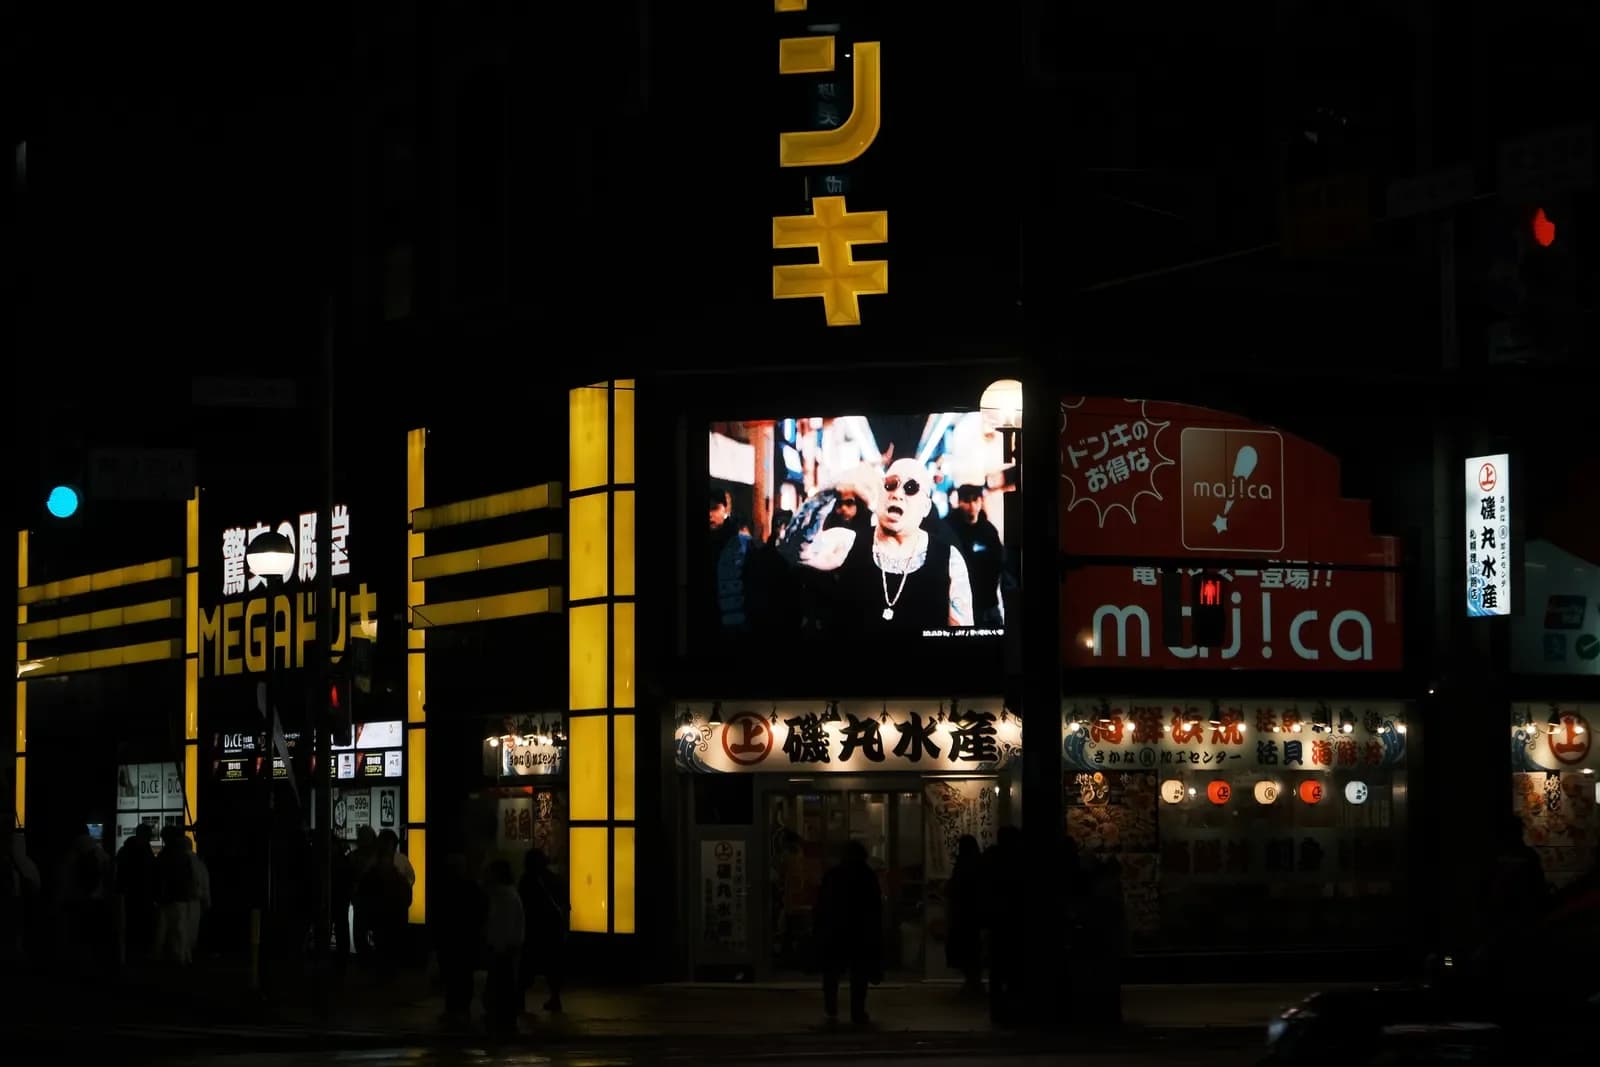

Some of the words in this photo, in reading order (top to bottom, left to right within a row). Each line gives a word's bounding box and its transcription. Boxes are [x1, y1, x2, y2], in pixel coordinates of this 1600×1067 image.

[772, 0, 888, 327] ンキ
[1067, 420, 1149, 469] ドンキの
[1084, 447, 1151, 493] お得な
[1480, 496, 1498, 610] 磯丸水産
[783, 710, 999, 764] 磯丸水産
[1257, 740, 1303, 765] 活貝
